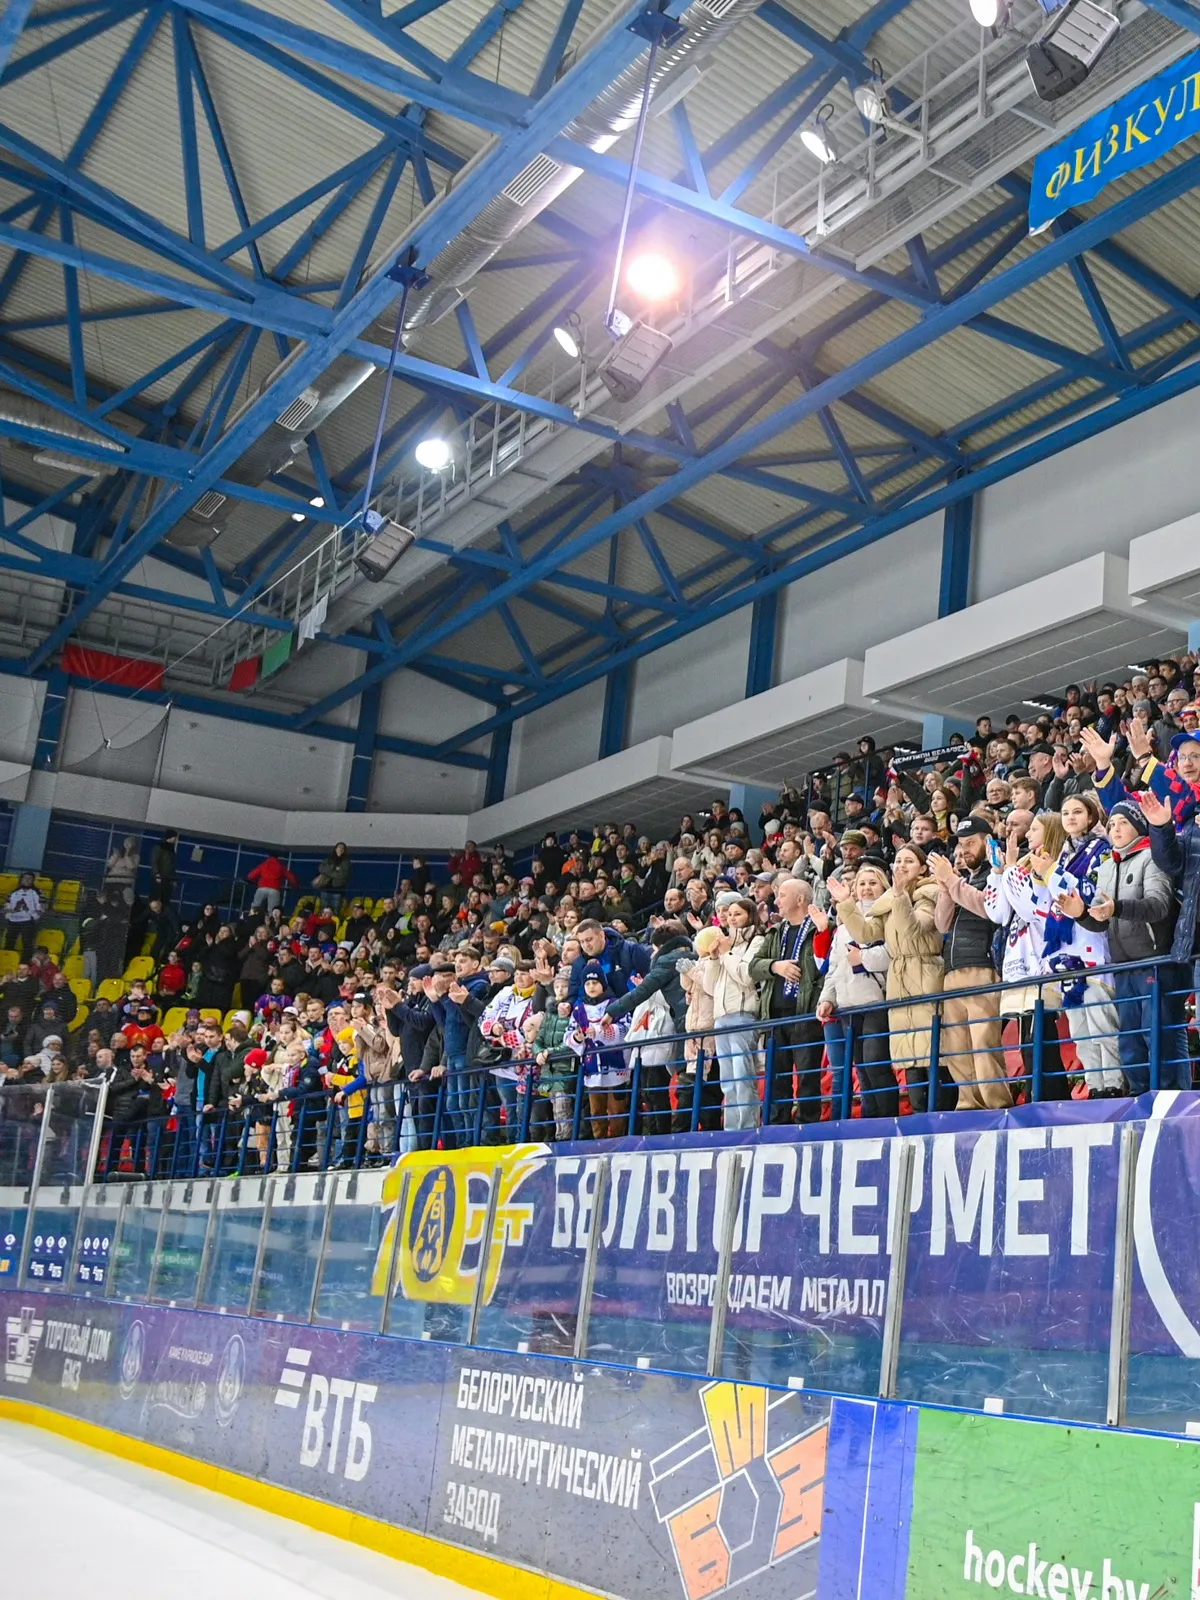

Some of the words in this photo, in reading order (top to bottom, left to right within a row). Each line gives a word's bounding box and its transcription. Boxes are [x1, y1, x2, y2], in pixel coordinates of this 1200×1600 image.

[551, 1123, 1114, 1256] БЕЛВТОРЧЕРМЕТ
[800, 1276, 885, 1317] МЕТАЛЛ
[45, 1319, 91, 1356] ТОРГОВЫЙ
[86, 1328, 111, 1364] ДОМ
[299, 1374, 378, 1481] ВТБ
[457, 1368, 584, 1429] БЕЛОРУССКИЙ
[450, 1424, 642, 1510] МЕТАЛЛУРГИЧЕСКИЙ
[443, 1481, 501, 1545] ЗАВОД
